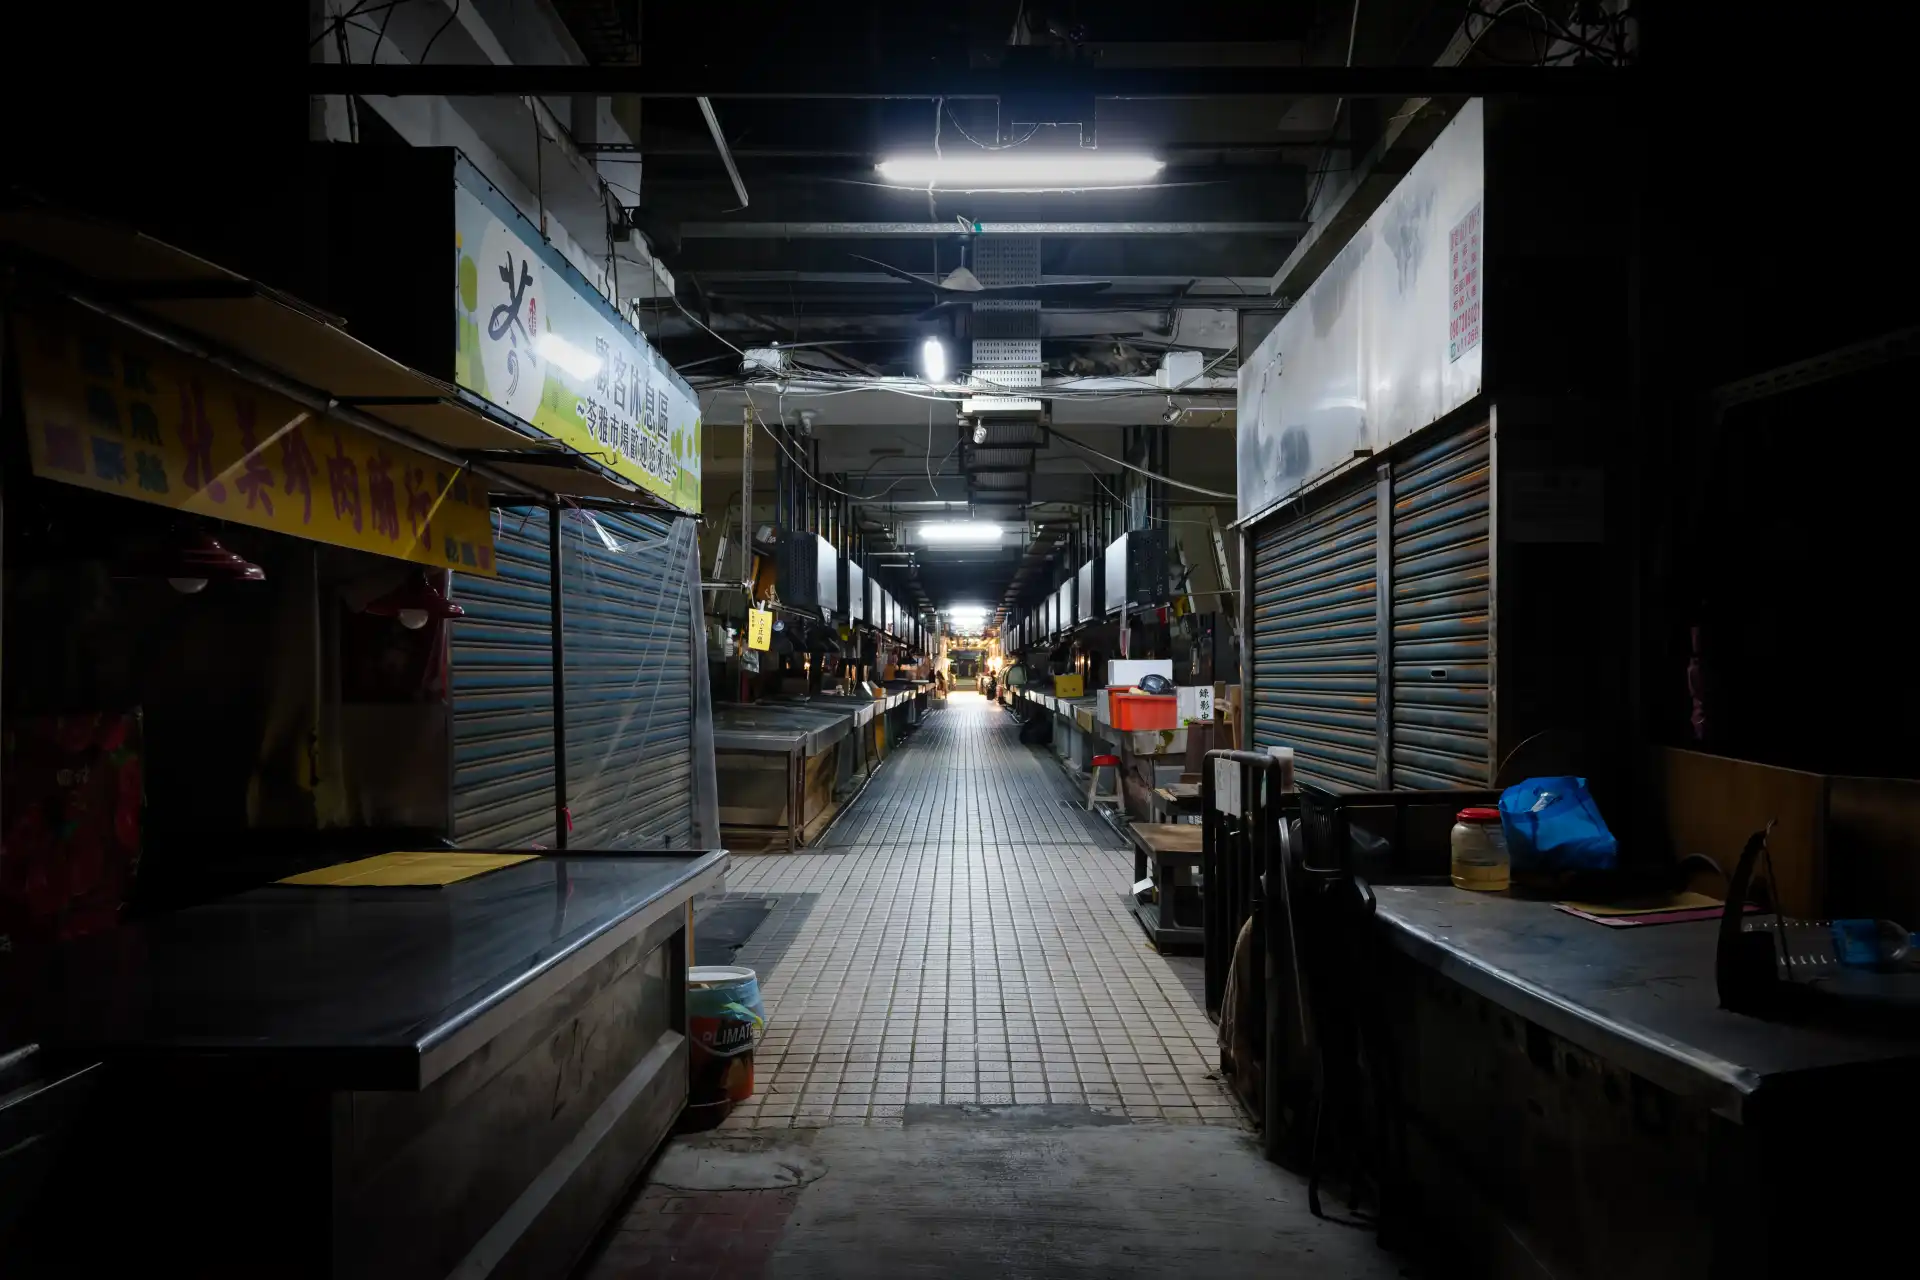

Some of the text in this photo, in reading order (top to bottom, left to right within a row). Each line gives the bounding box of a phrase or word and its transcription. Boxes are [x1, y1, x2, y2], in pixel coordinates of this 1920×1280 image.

[594, 335, 669, 443] 顧客休息區
[1199, 688, 1210, 720] 錄影中
